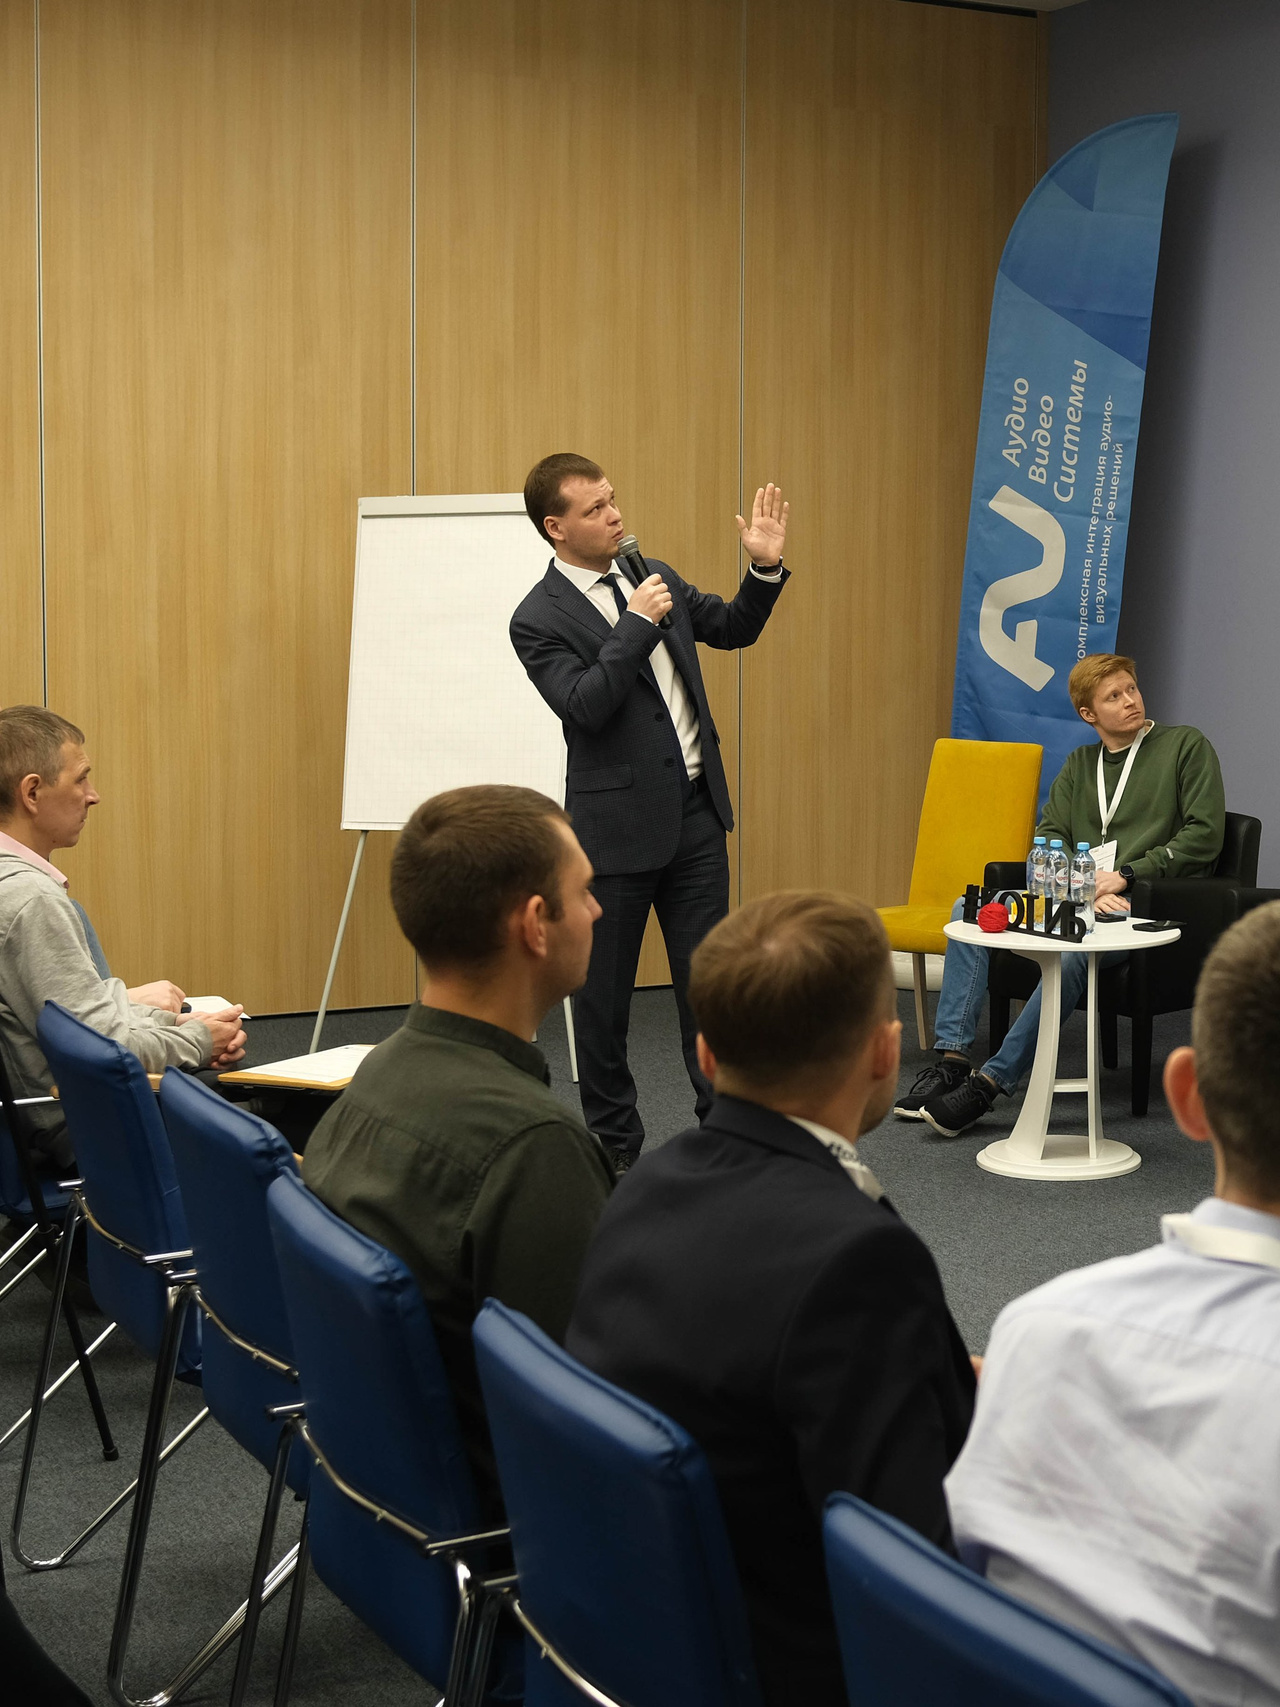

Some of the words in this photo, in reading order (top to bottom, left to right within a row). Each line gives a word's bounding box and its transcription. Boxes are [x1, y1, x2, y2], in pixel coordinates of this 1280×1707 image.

[1002, 377, 1030, 468] Аудио
[1028, 395, 1054, 486] Видео
[1053, 359, 1088, 503] Системы
[1077, 558, 1093, 663] омплексная
[1086, 456, 1107, 554] интеграция
[1100, 395, 1113, 452] аудио-
[1096, 525, 1114, 624] визуальных
[1105, 443, 1124, 521] решений
